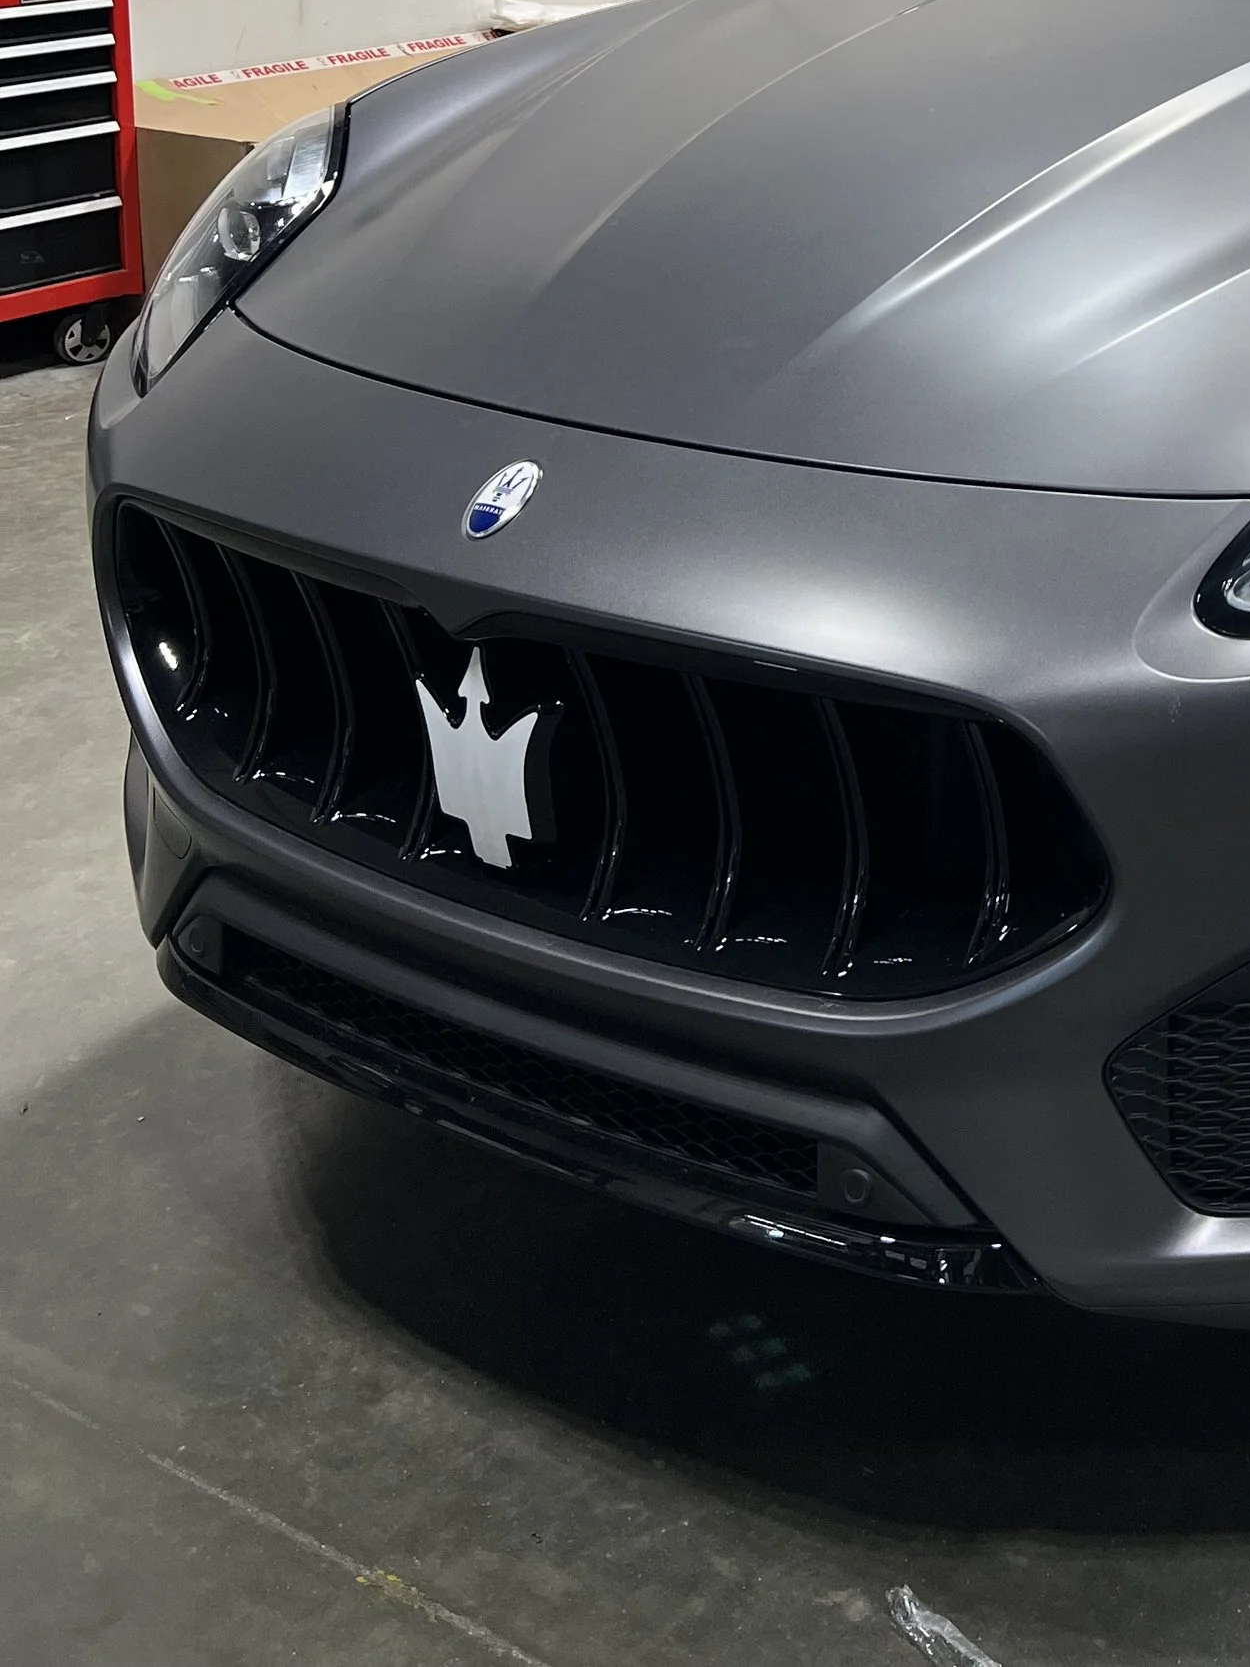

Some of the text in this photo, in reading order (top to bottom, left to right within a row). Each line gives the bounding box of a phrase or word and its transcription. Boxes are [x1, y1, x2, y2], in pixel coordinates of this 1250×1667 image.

[173, 74, 223, 88] AGILE
[242, 60, 309, 78] FRAGILE
[327, 48, 390, 65] FRAGILE
[407, 36, 466, 52] FRAGILE
[474, 504, 503, 515] MASERAT
